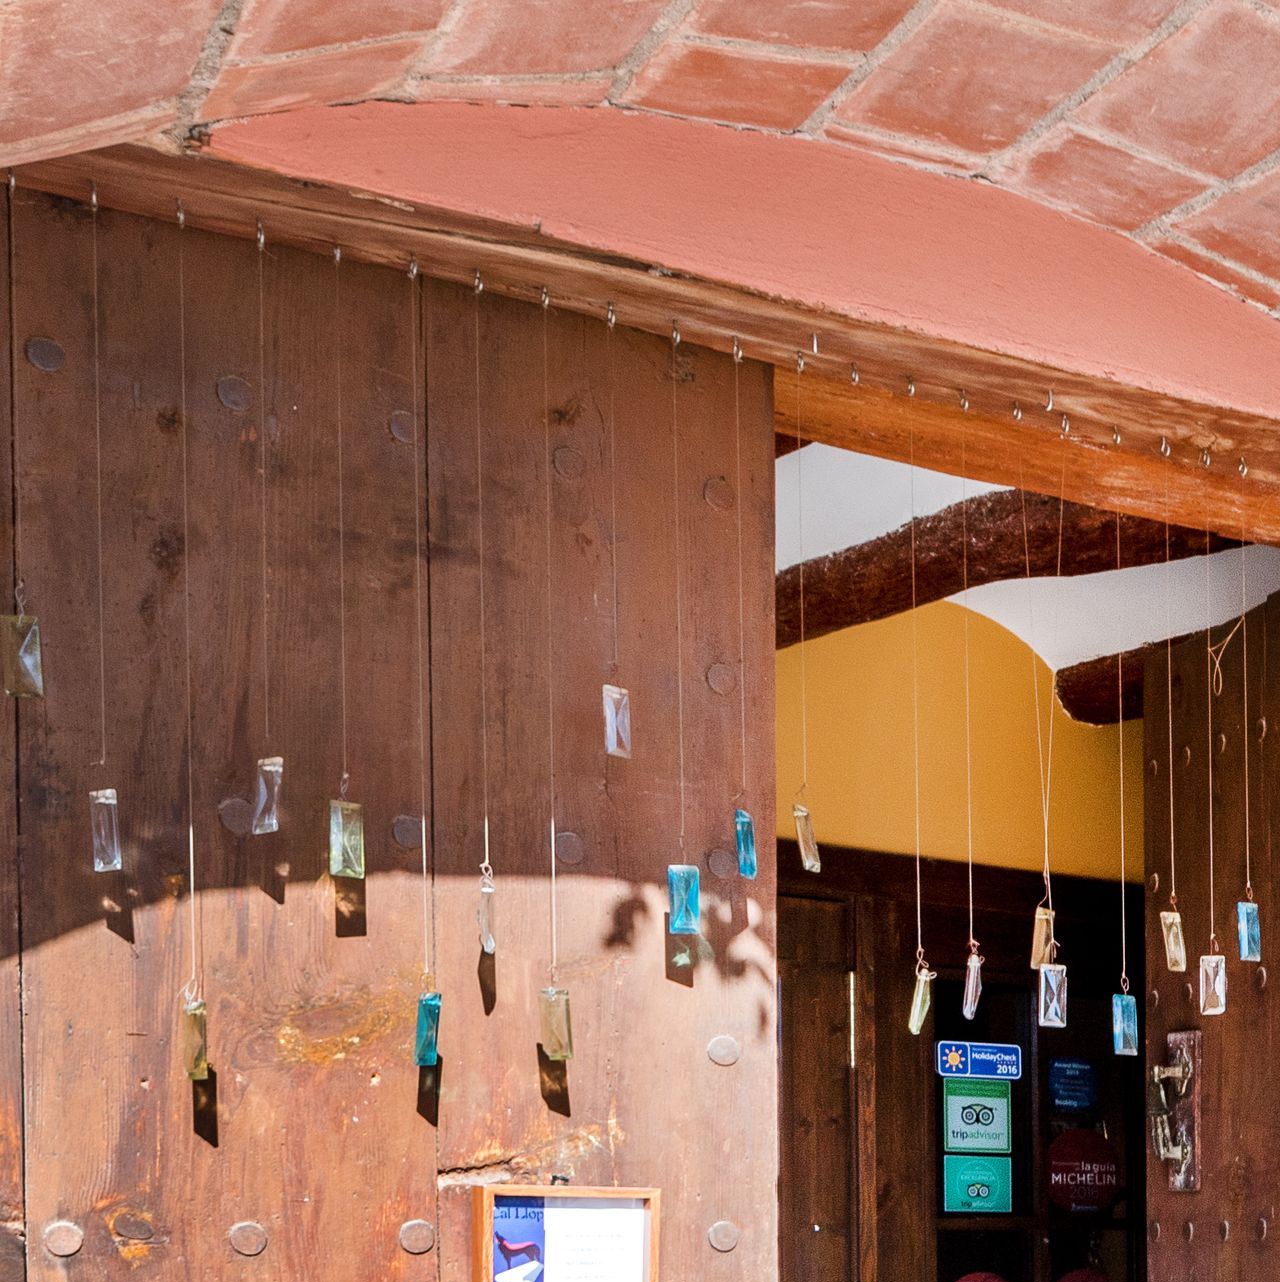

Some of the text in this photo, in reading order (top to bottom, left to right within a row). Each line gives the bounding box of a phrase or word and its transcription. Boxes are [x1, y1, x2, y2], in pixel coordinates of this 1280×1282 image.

[971, 1052, 1017, 1062] HolidayCheck
[996, 1064, 1018, 1075] 2016
[951, 1129, 1002, 1141] tripadvisor
[1081, 1161, 1091, 1171] la
[1051, 1173, 1116, 1185] MICHELIN
